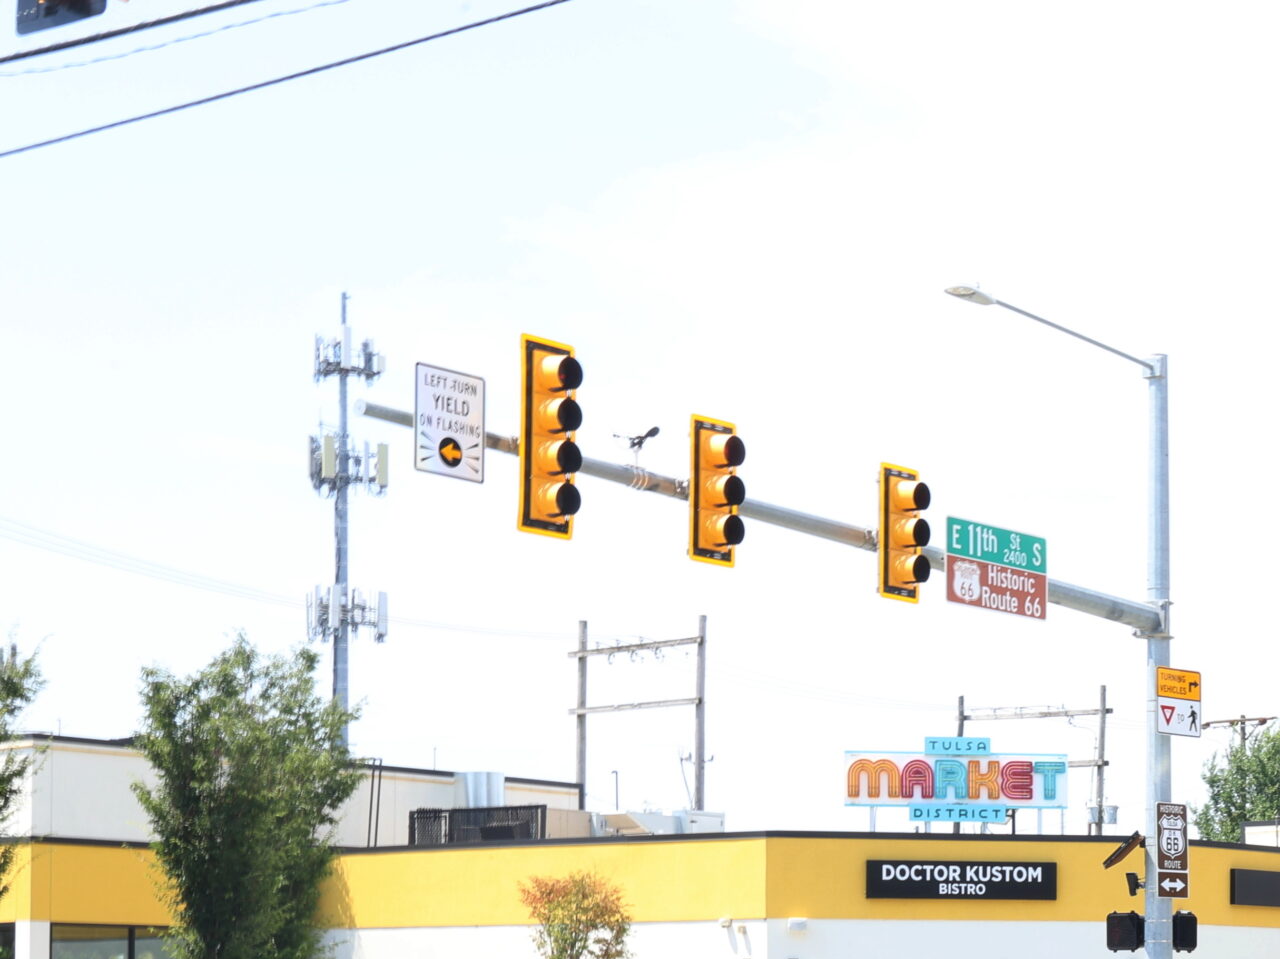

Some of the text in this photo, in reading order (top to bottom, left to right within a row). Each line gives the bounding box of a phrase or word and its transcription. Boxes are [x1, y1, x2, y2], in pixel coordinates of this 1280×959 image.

[424, 372, 478, 397] LEFT TURN
[432, 393, 470, 417] YIELD
[419, 412, 481, 439] ON FLASHING
[952, 524, 1042, 567] E 11th St S
[1003, 549, 1027, 567] 2400
[988, 564, 1036, 594] Historic
[960, 581, 974, 598] 66
[981, 586, 1041, 617] Route 66
[1160, 672, 1187, 683] TURNING
[1160, 684, 1187, 696] VEHICLES
[929, 740, 987, 752] TULSA
[847, 758, 1066, 801] MARKET
[913, 808, 1002, 820] DISTRICT
[1159, 804, 1184, 815] HISTORIC
[1166, 837, 1180, 852] 66
[1164, 859, 1182, 869] ROUTE
[881, 864, 1042, 883] DOCTOR KUSTOM
[938, 883, 986, 896] BISTRO
